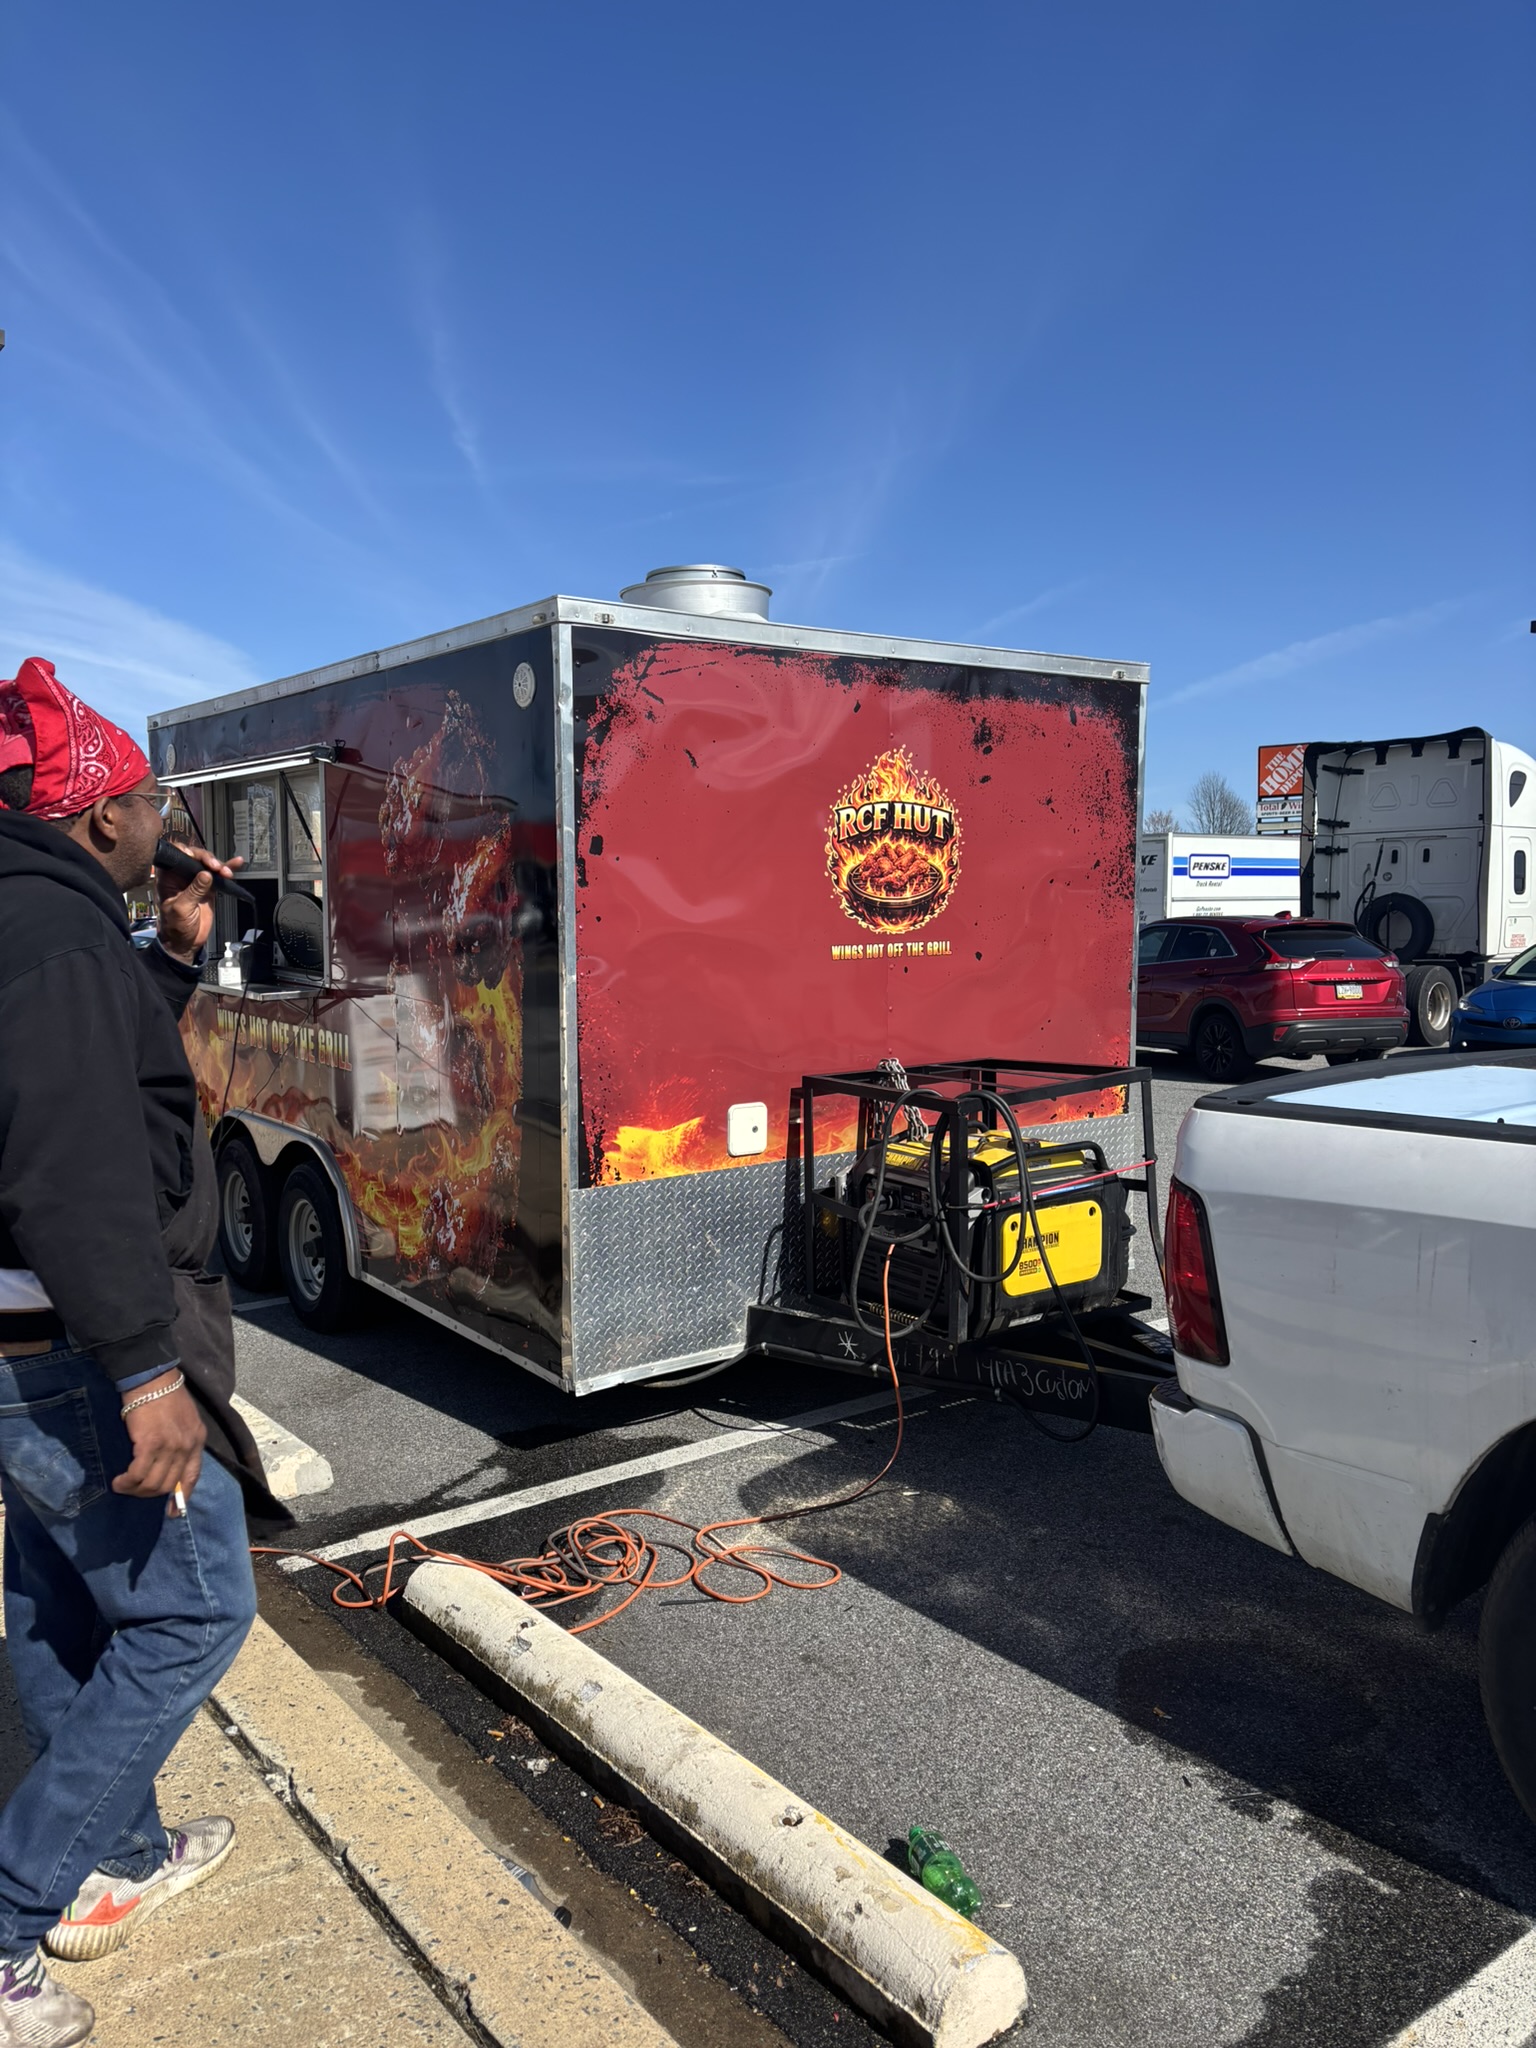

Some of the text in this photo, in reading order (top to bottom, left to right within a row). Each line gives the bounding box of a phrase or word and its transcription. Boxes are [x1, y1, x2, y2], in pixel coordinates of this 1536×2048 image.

[1265, 752, 1286, 771] THE
[1279, 764, 1304, 794] DEPO
[1260, 802, 1279, 811] Total
[838, 802, 951, 840] RCF HUT
[1192, 862, 1227, 871] PENSKE
[831, 941, 952, 960] WINGS HOT OFF THE GRILL
[249, 1015, 268, 1050] HOT
[271, 1020, 290, 1056] OFF
[293, 1025, 315, 1063] THE
[318, 1028, 352, 1072] GRILL
[1019, 1259, 1037, 1270] 8500
